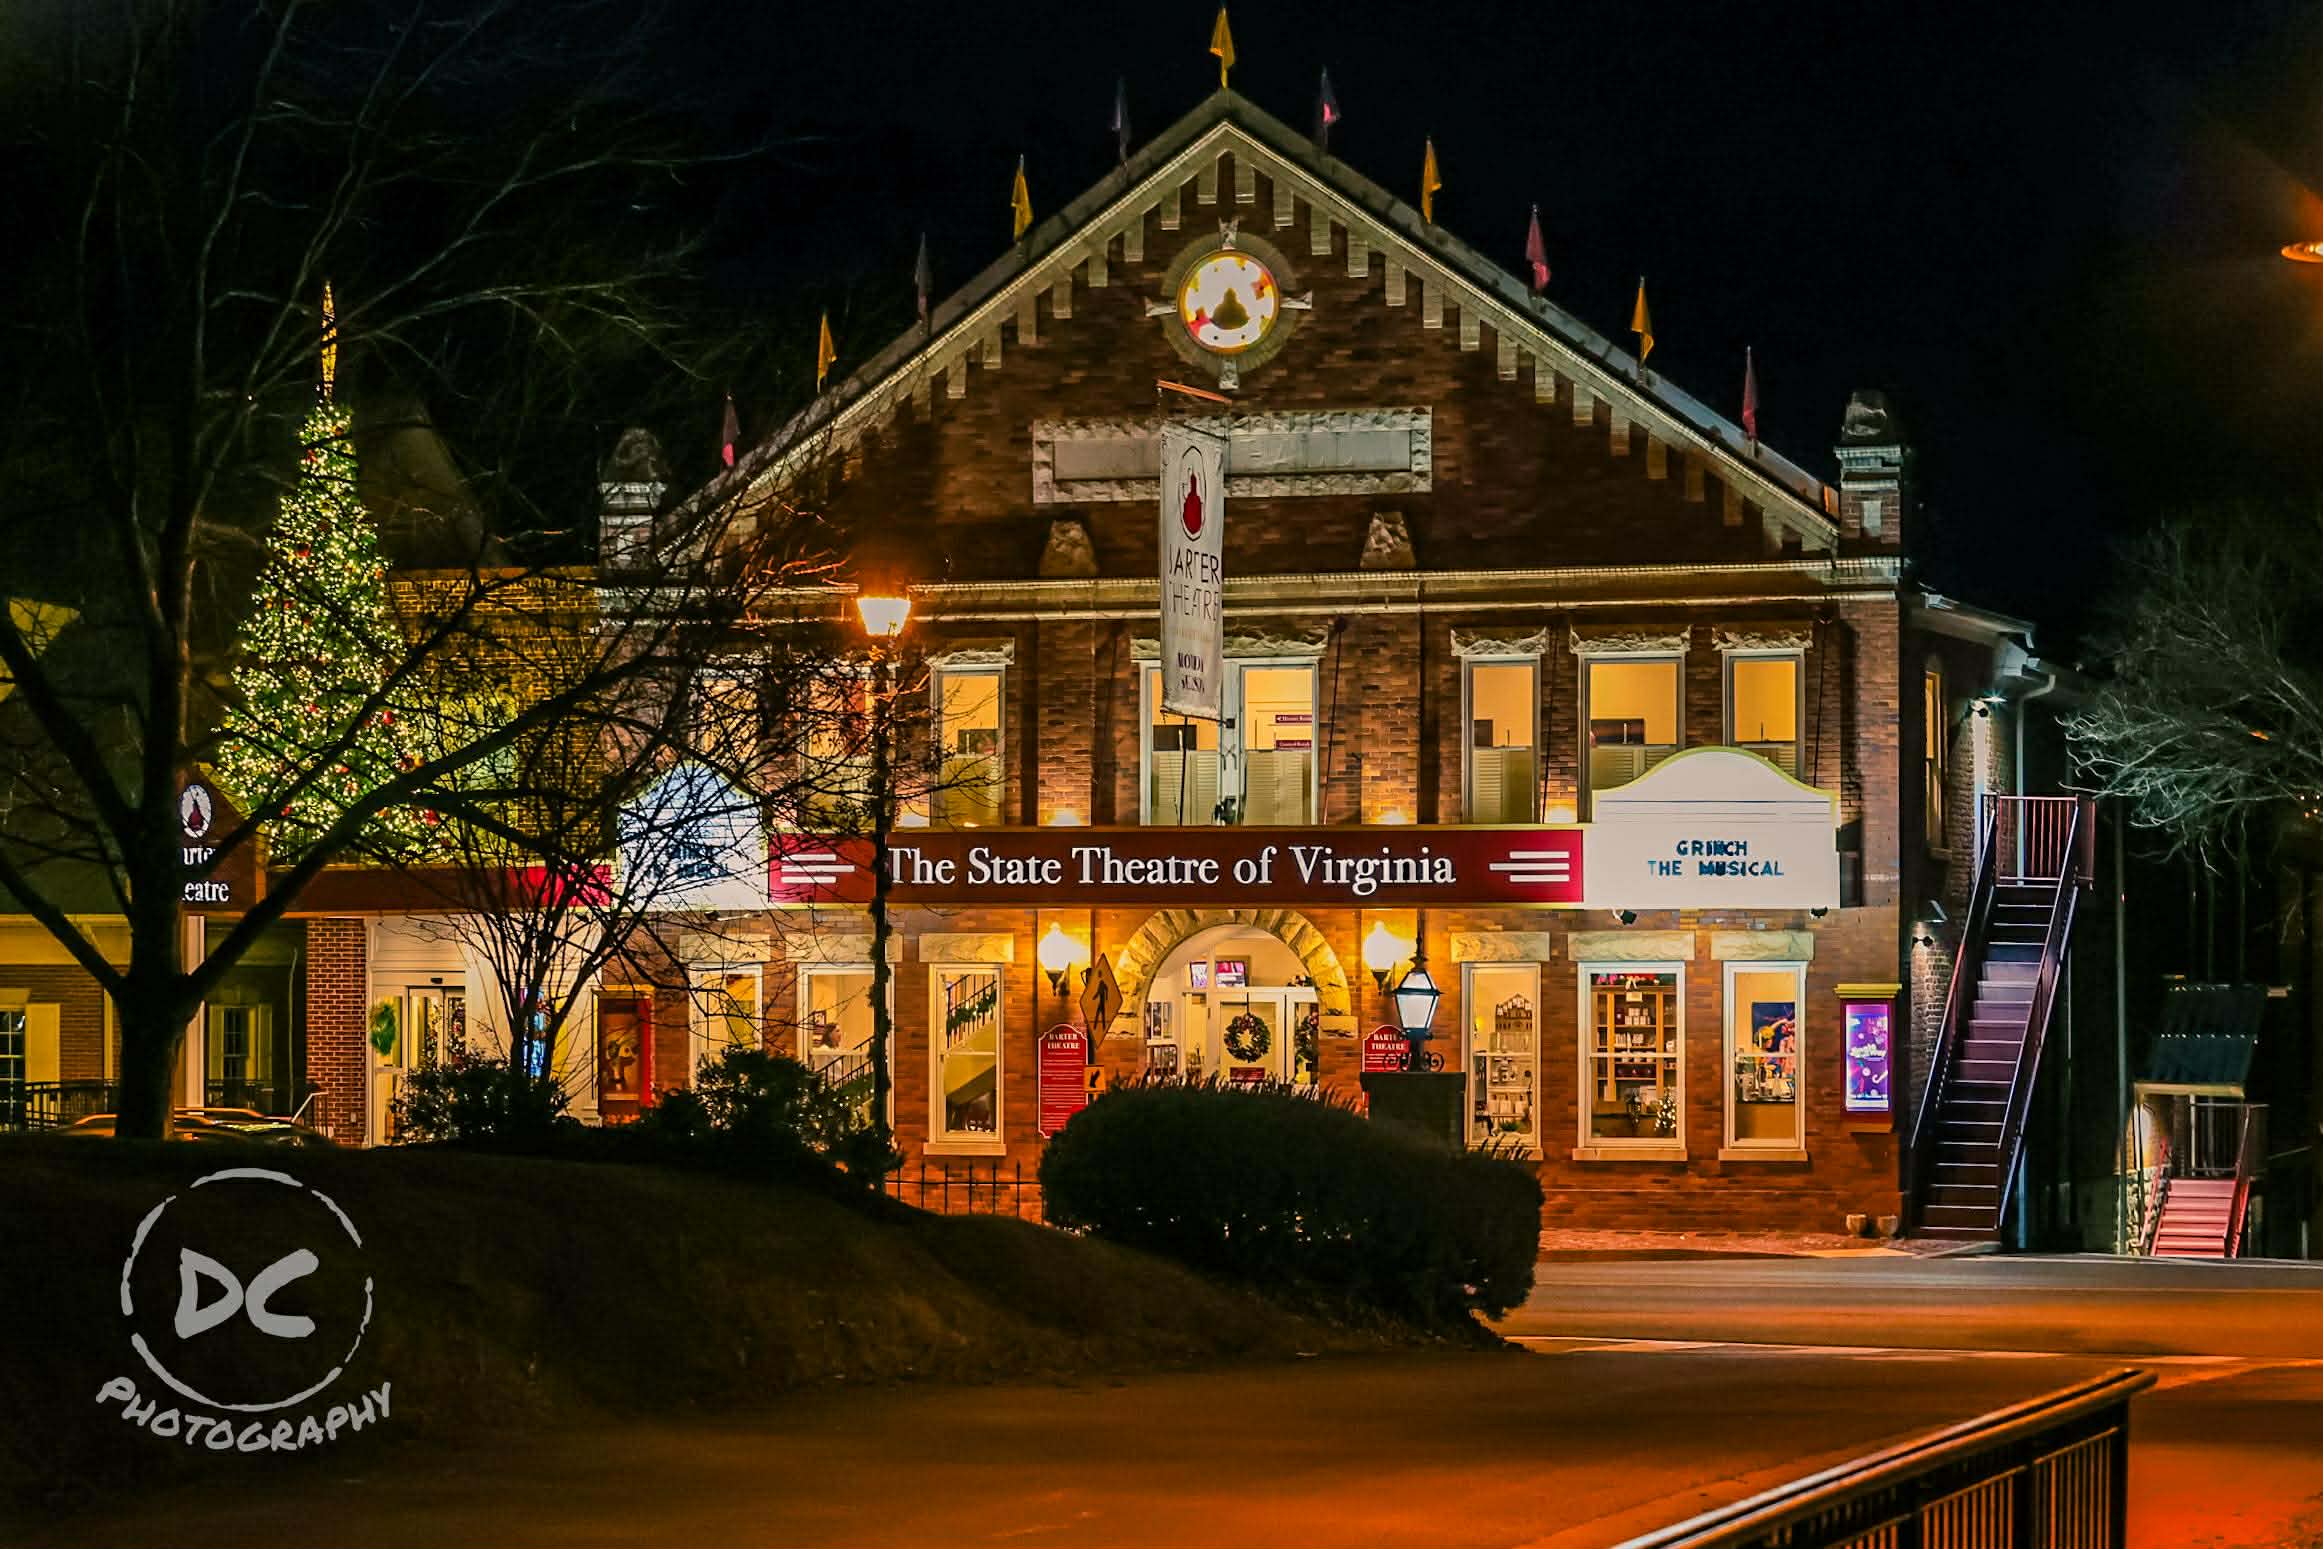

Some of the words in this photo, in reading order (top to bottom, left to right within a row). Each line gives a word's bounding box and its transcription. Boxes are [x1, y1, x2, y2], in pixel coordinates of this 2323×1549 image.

[1676, 840, 1747, 856] GRINCH
[888, 847, 956, 884] The
[967, 847, 1062, 884] State
[1071, 847, 1219, 884] Theatre
[1233, 846, 1277, 884] of
[1288, 846, 1456, 896] Virginia
[1647, 860, 1682, 876] THE
[1698, 860, 1784, 876] MUSICAL
[183, 880, 229, 902] eatre
